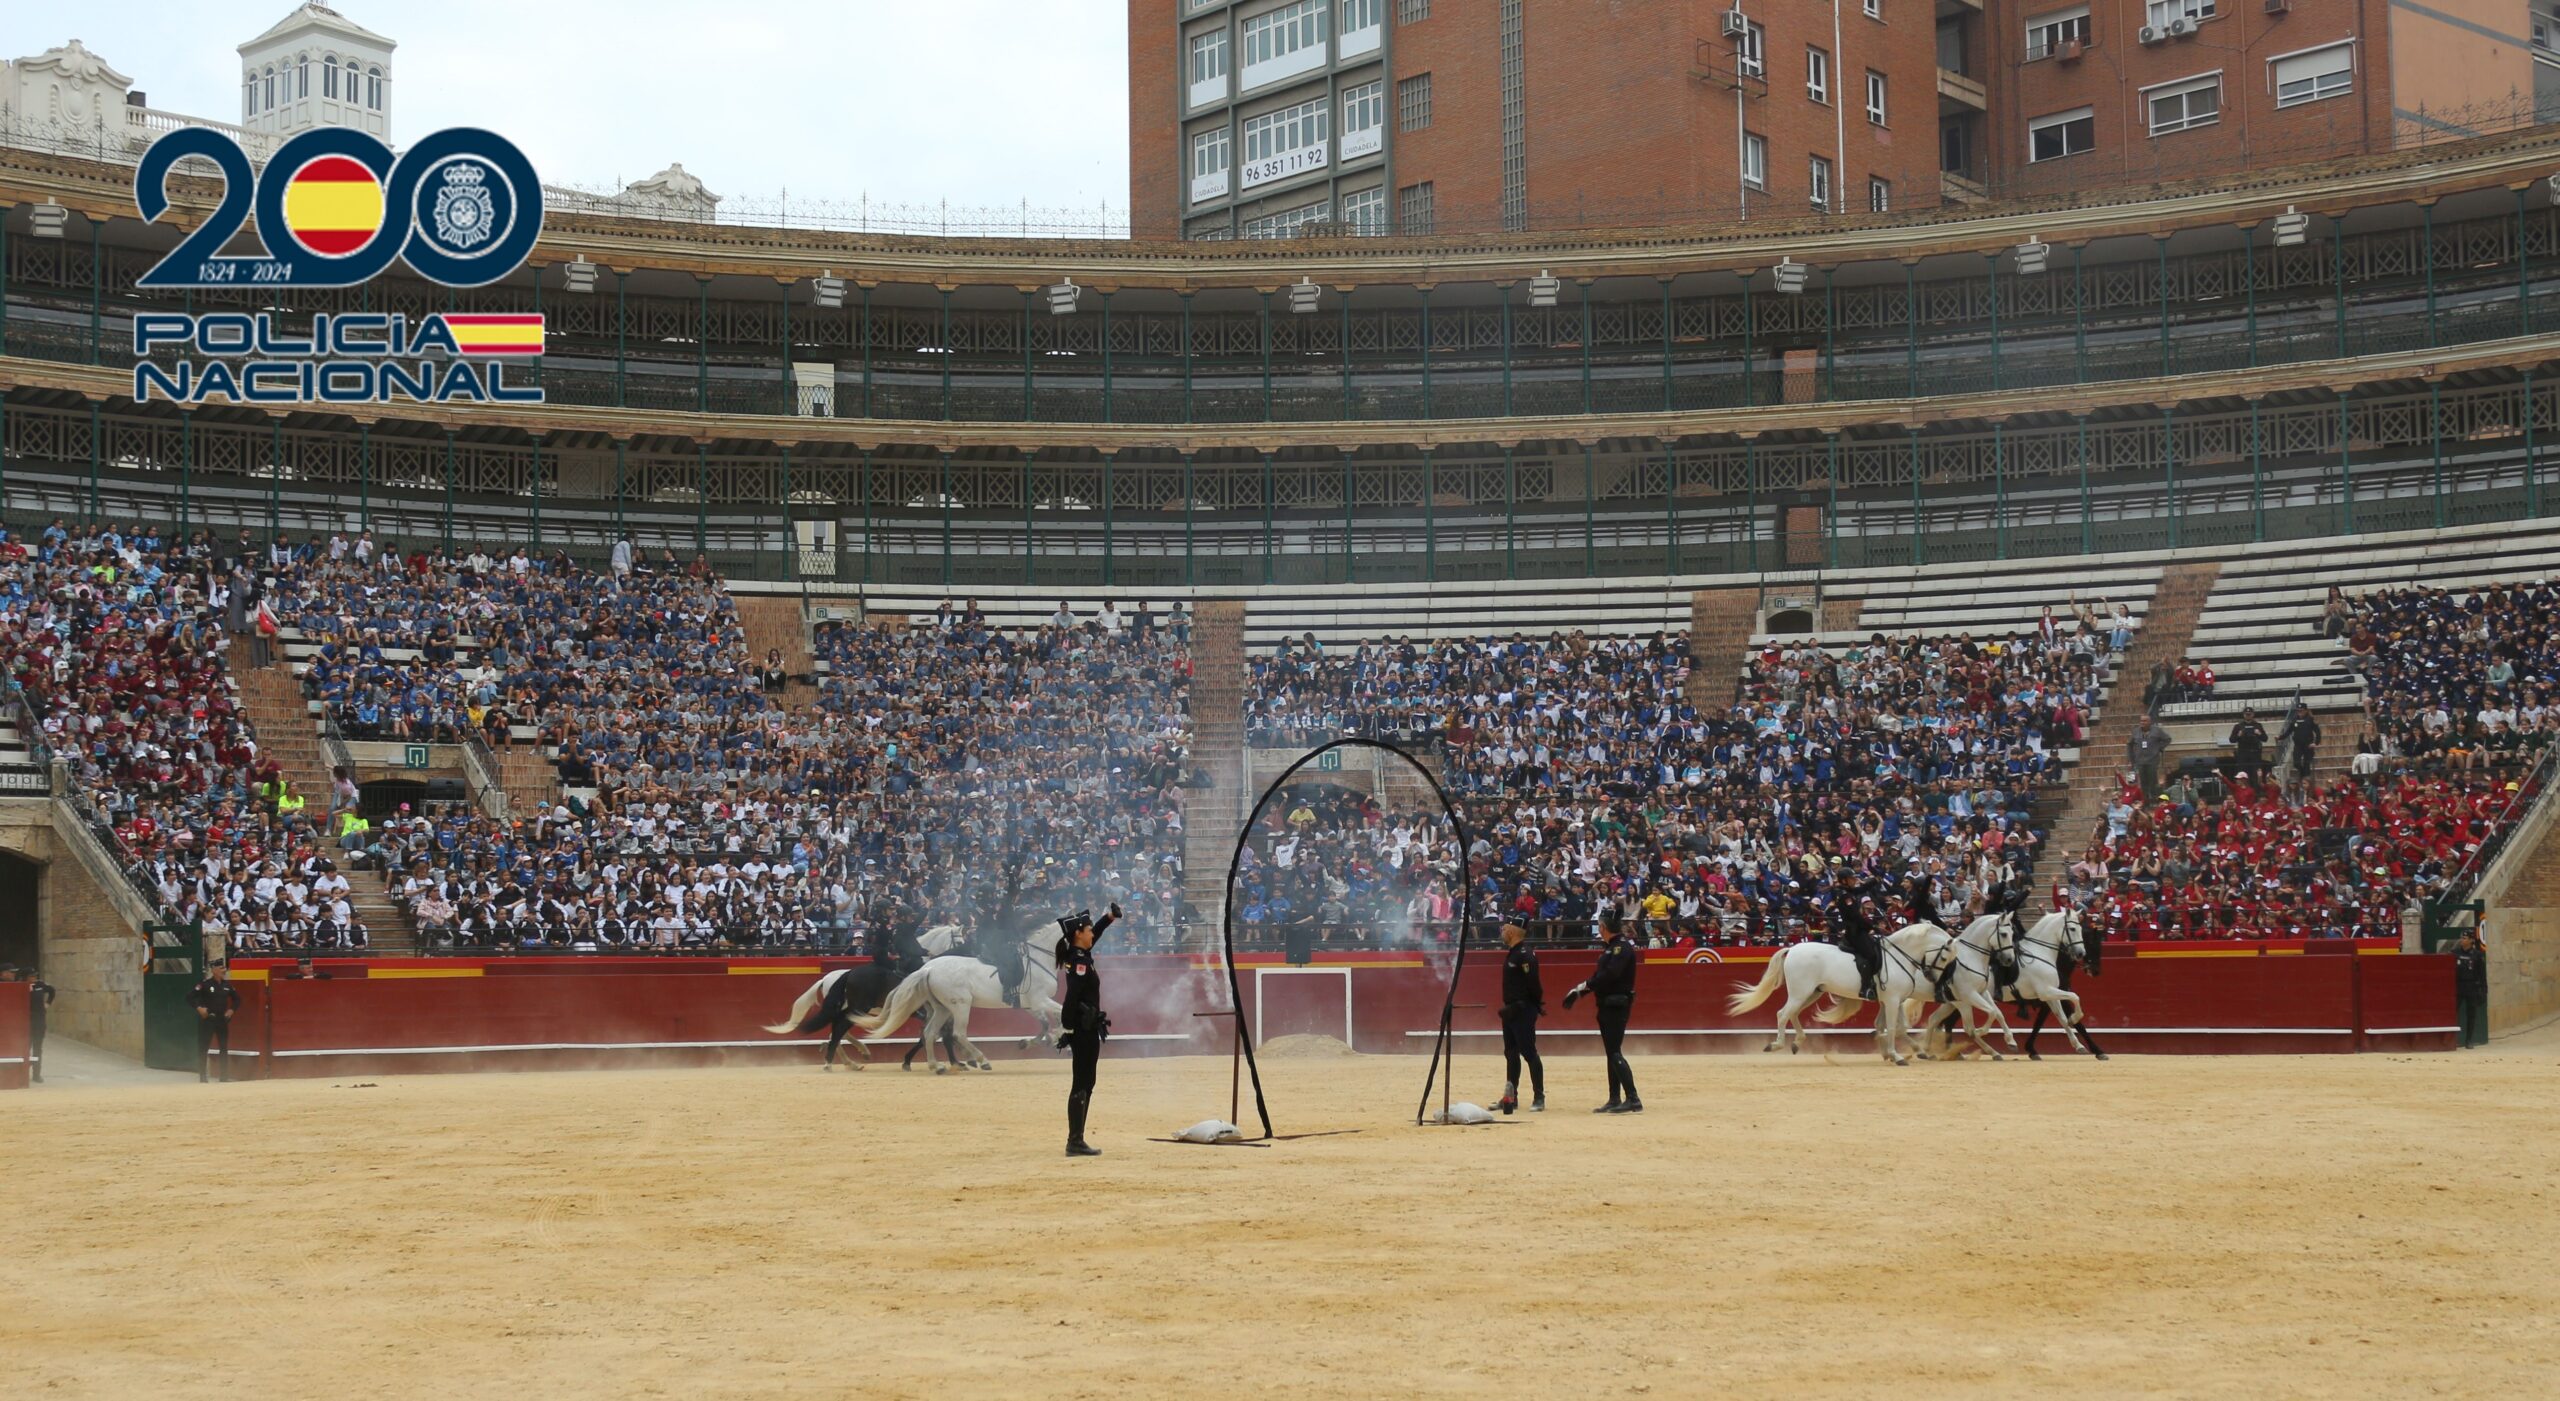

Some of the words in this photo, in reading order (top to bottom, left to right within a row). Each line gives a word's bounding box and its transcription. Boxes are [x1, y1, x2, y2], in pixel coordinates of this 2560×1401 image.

[1246, 166, 1260, 182] 96
[1263, 159, 1284, 177] 351
[1290, 154, 1302, 170] 11
[1307, 148, 1322, 165] 92
